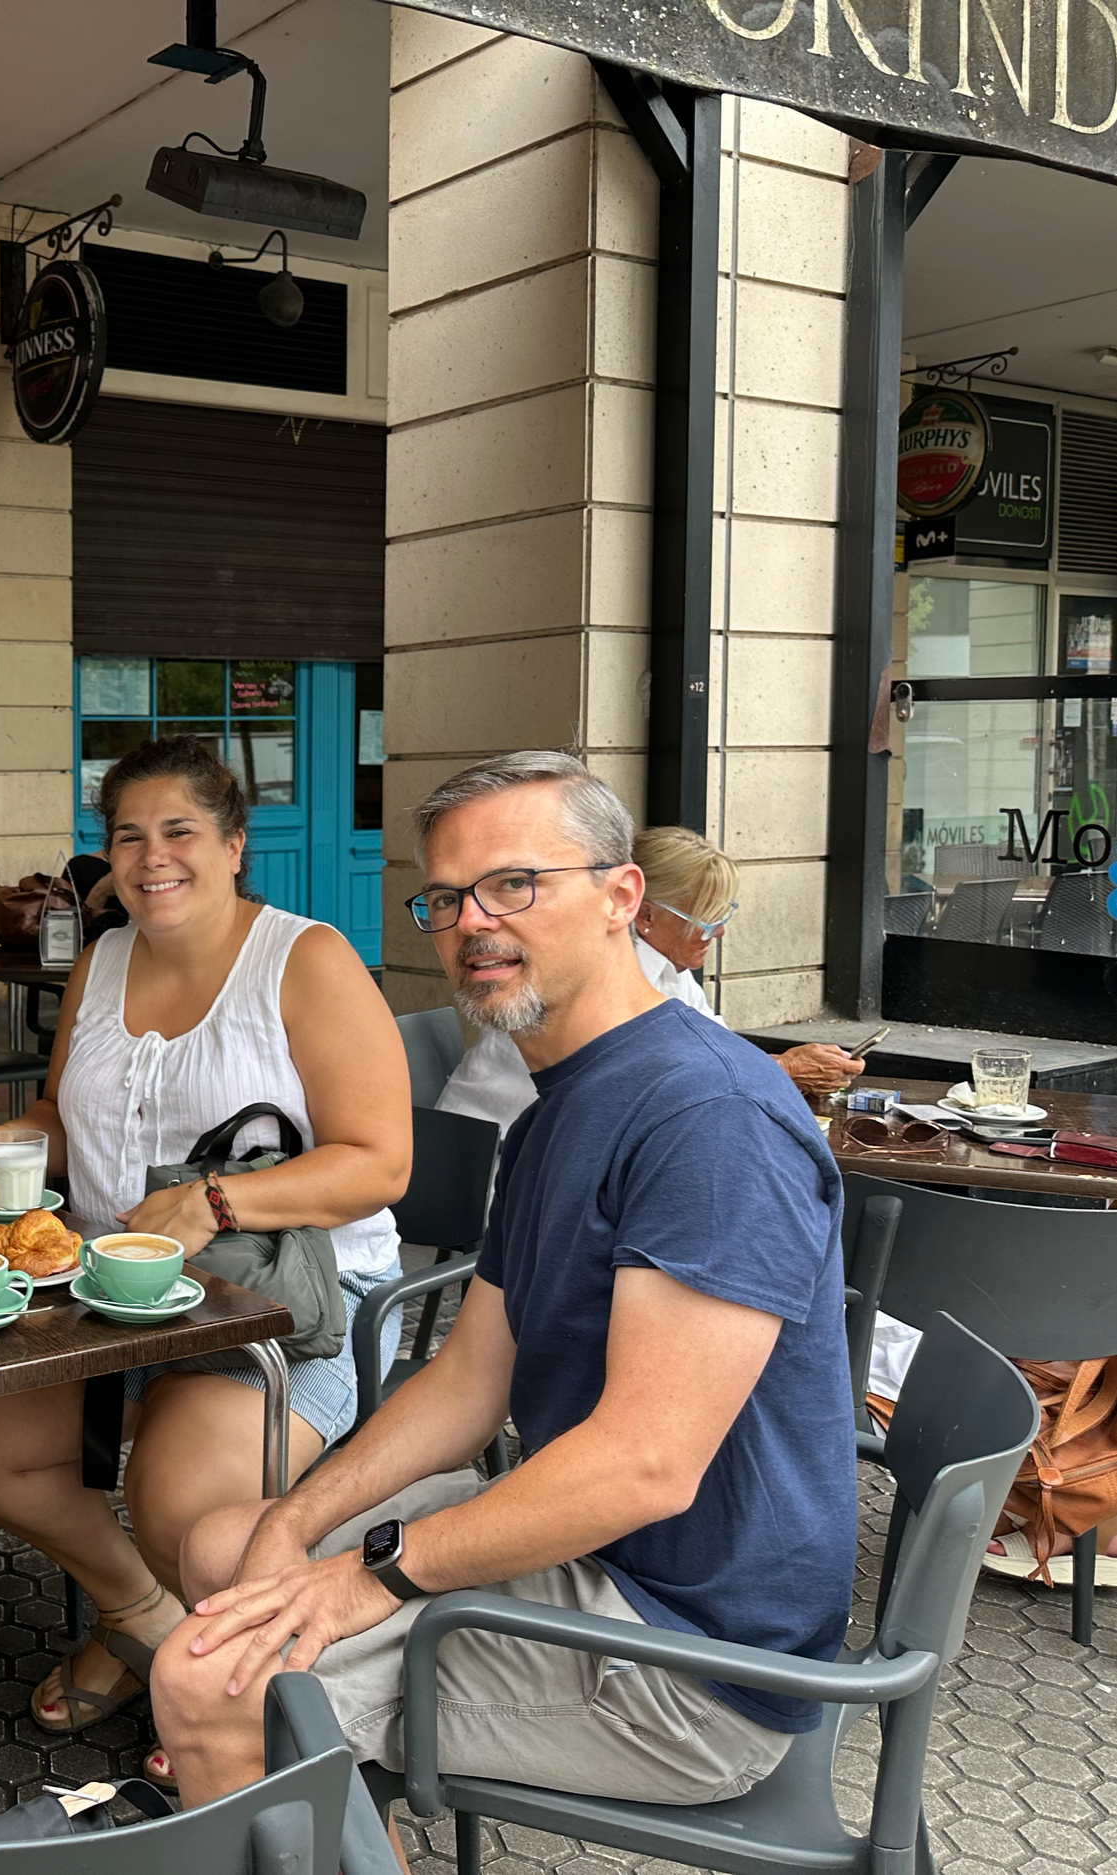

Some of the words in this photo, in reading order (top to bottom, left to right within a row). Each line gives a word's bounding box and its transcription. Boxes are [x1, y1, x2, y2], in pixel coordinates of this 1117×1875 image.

[978, 470, 1042, 501] VILES
[998, 503, 1041, 519] DONOSTI
[926, 821, 985, 847] MÓVILES
